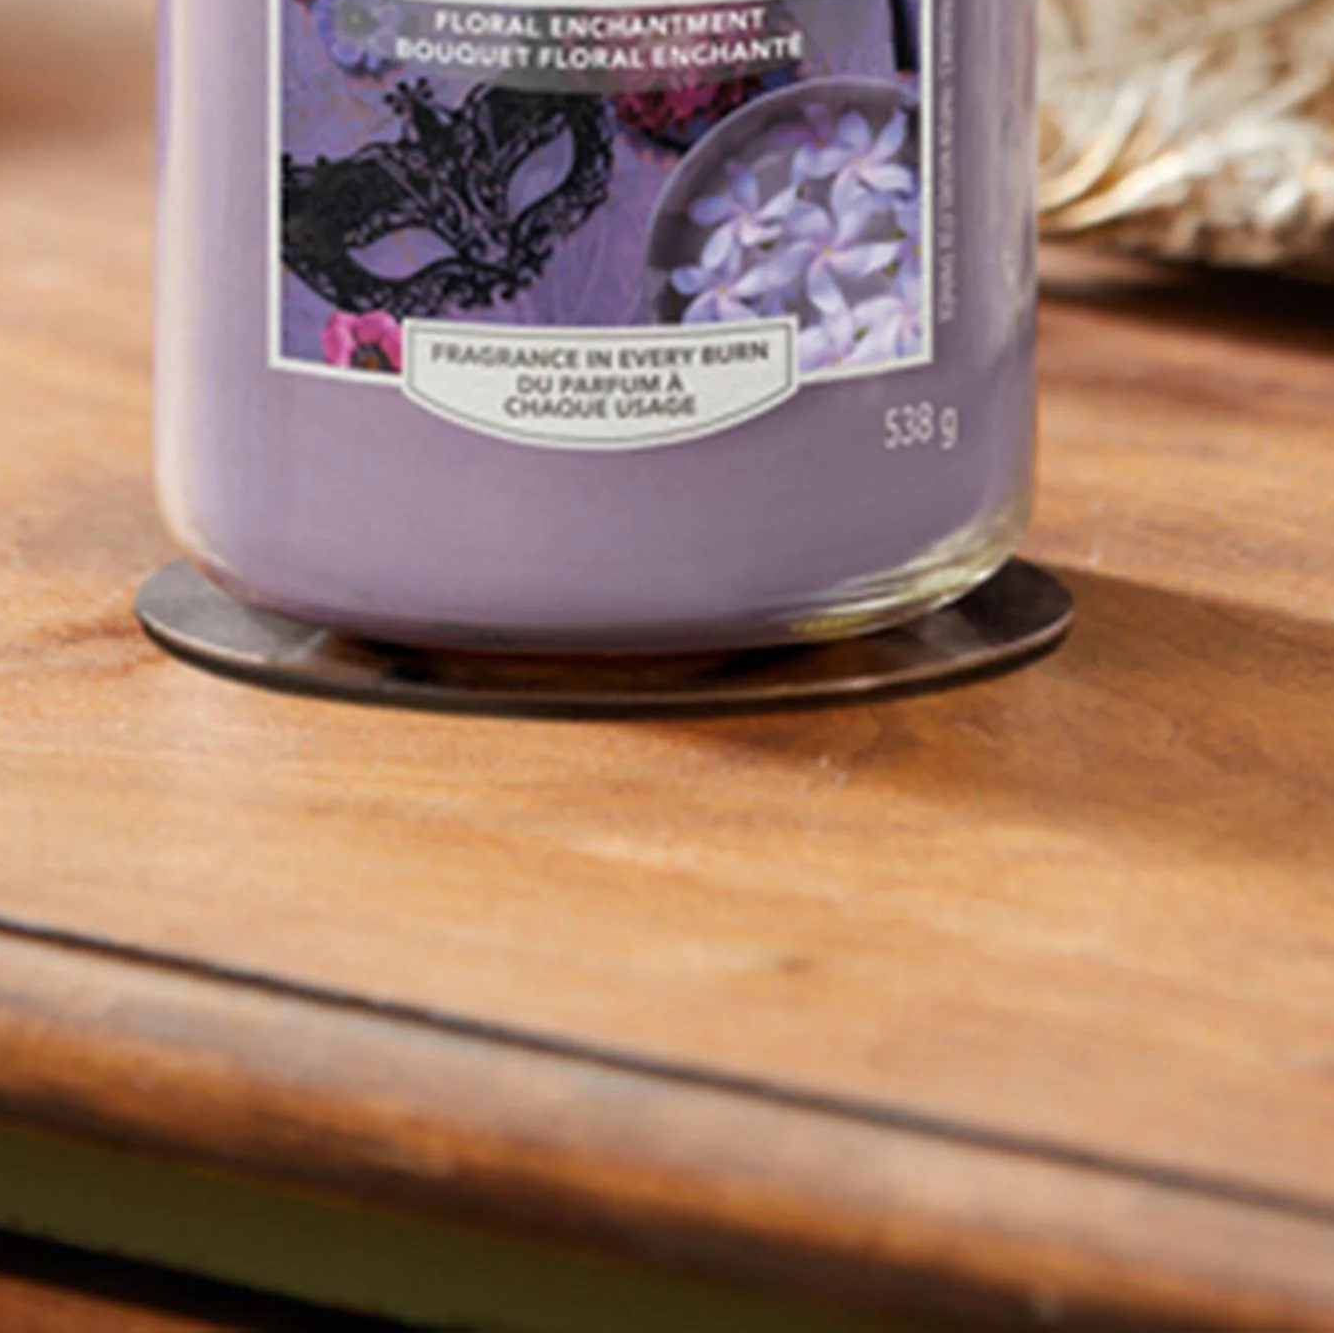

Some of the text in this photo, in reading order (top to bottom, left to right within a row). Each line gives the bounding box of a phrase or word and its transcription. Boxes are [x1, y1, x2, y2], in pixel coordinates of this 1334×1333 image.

[435, 8, 765, 38] FLORAL ENCHANTMENT
[395, 33, 804, 71] BOUQUET FLORAL ENCHANTÉ
[431, 340, 770, 369] FRAGRANCE IN EVERY BURN
[516, 368, 686, 397] DU PARFUM À
[503, 394, 697, 420] CHAQUE USAGE
[884, 401, 959, 449] 538 g
